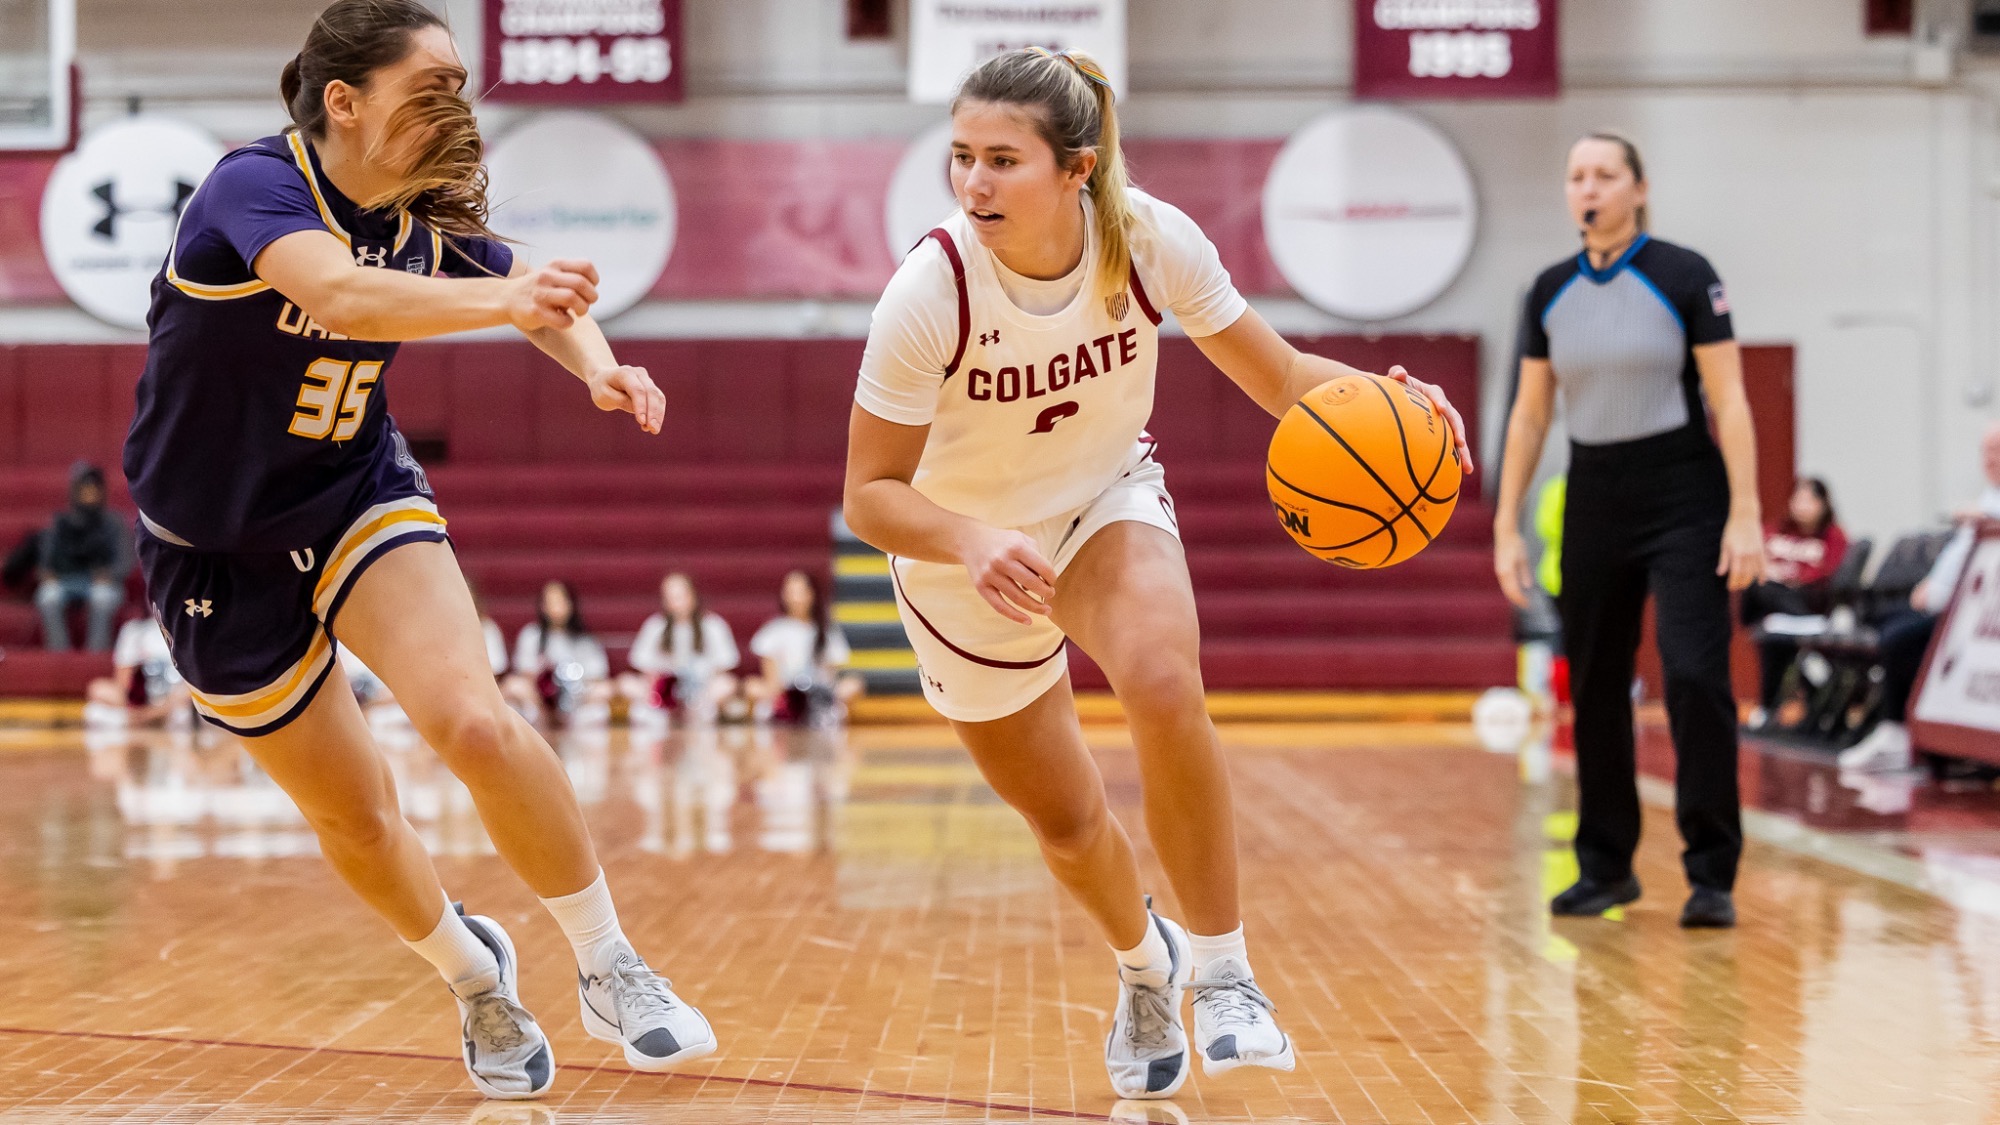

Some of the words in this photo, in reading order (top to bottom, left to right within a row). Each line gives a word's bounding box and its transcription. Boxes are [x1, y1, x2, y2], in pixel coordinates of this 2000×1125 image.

[501, 37, 672, 84] 1994-95
[1408, 31, 1512, 78] 1995
[967, 327, 1138, 403] COLGATE
[287, 356, 385, 441] 35
